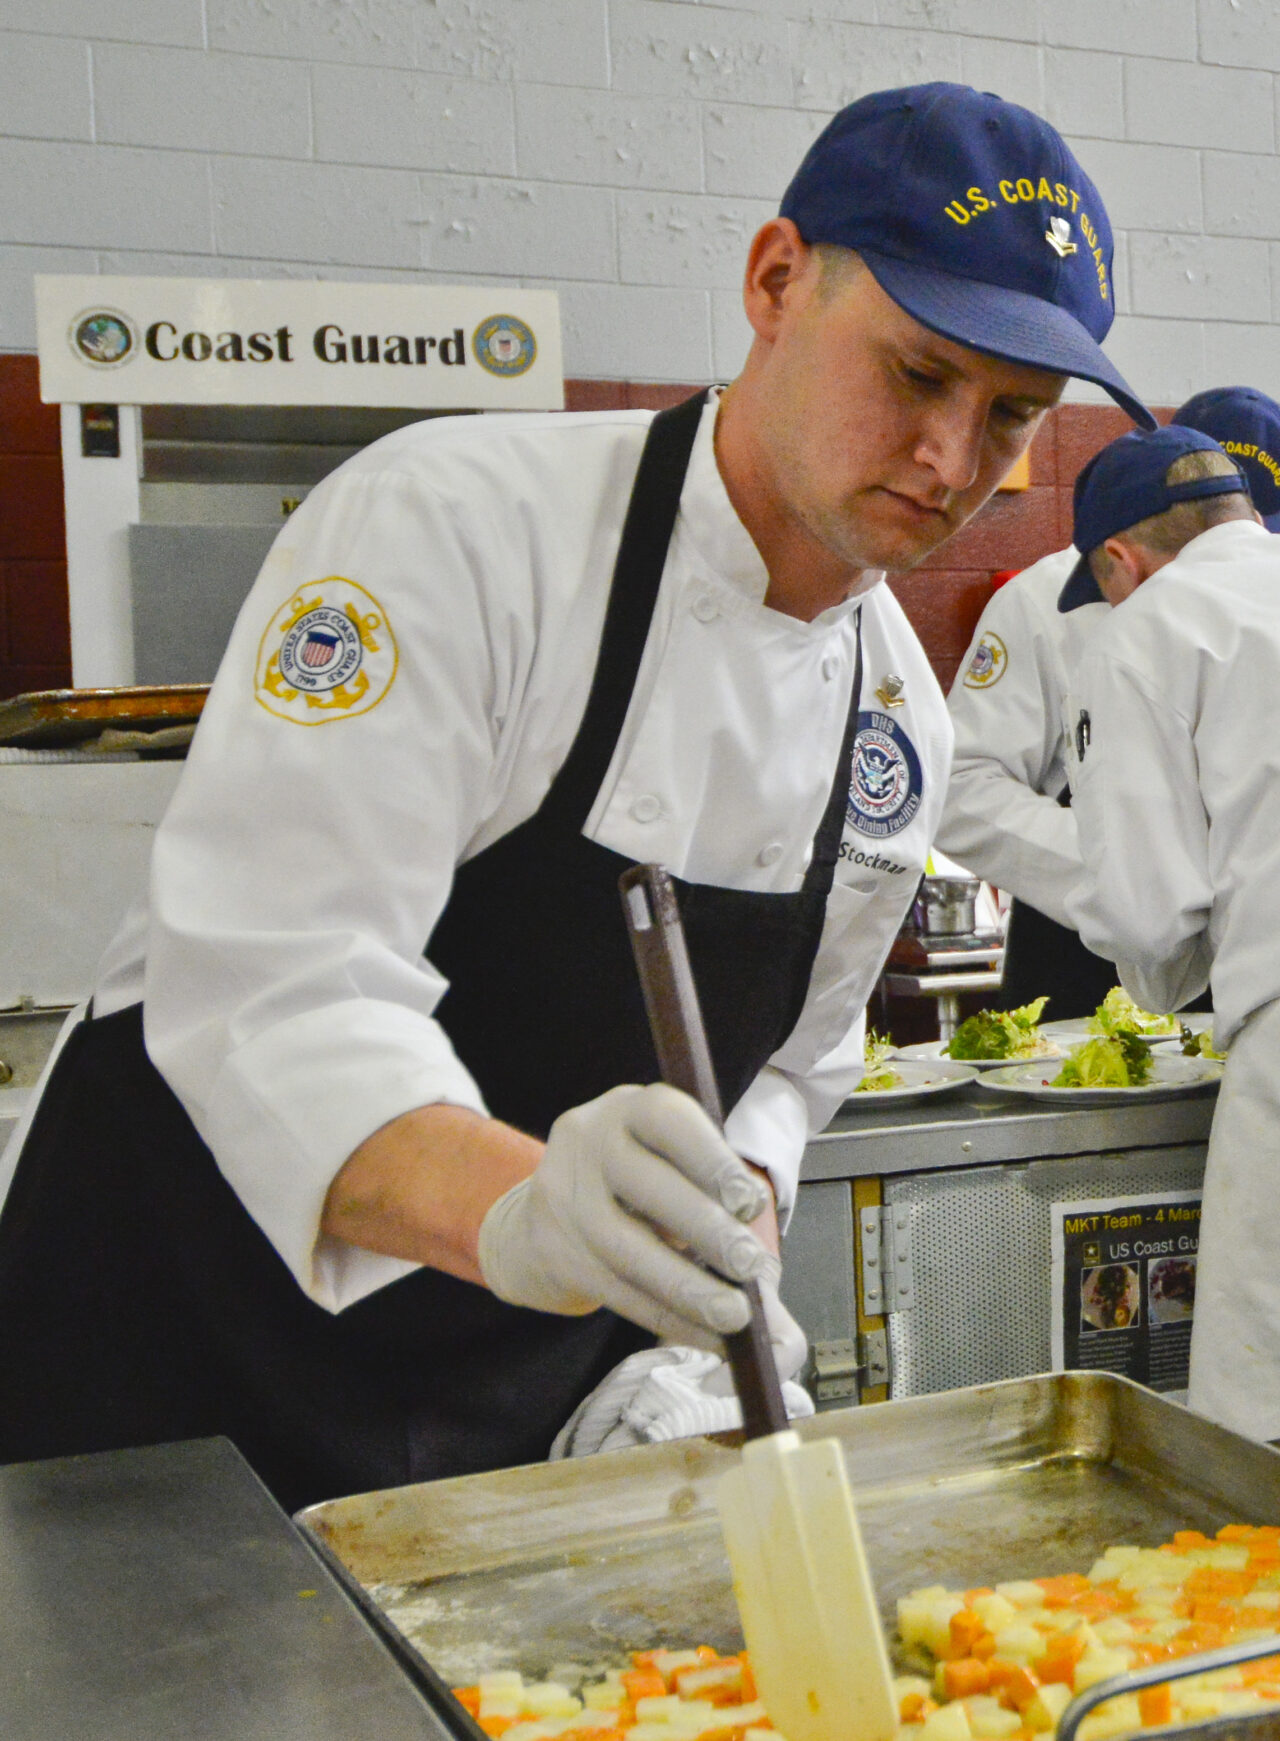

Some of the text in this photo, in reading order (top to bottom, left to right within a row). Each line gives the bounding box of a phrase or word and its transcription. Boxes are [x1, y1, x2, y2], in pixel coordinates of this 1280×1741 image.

[944, 186, 997, 225] U.S.
[999, 177, 1081, 213] COAST
[145, 321, 466, 366] Coast Guard
[283, 612, 357, 682] UNITED STATES COAST GUARD
[871, 713, 895, 735] DHS
[1065, 1215, 1099, 1234] MKT
[1103, 1213, 1142, 1229] Team
[1155, 1209, 1164, 1223] 4
[1109, 1242, 1130, 1259] US
[1133, 1239, 1174, 1256] Coast
